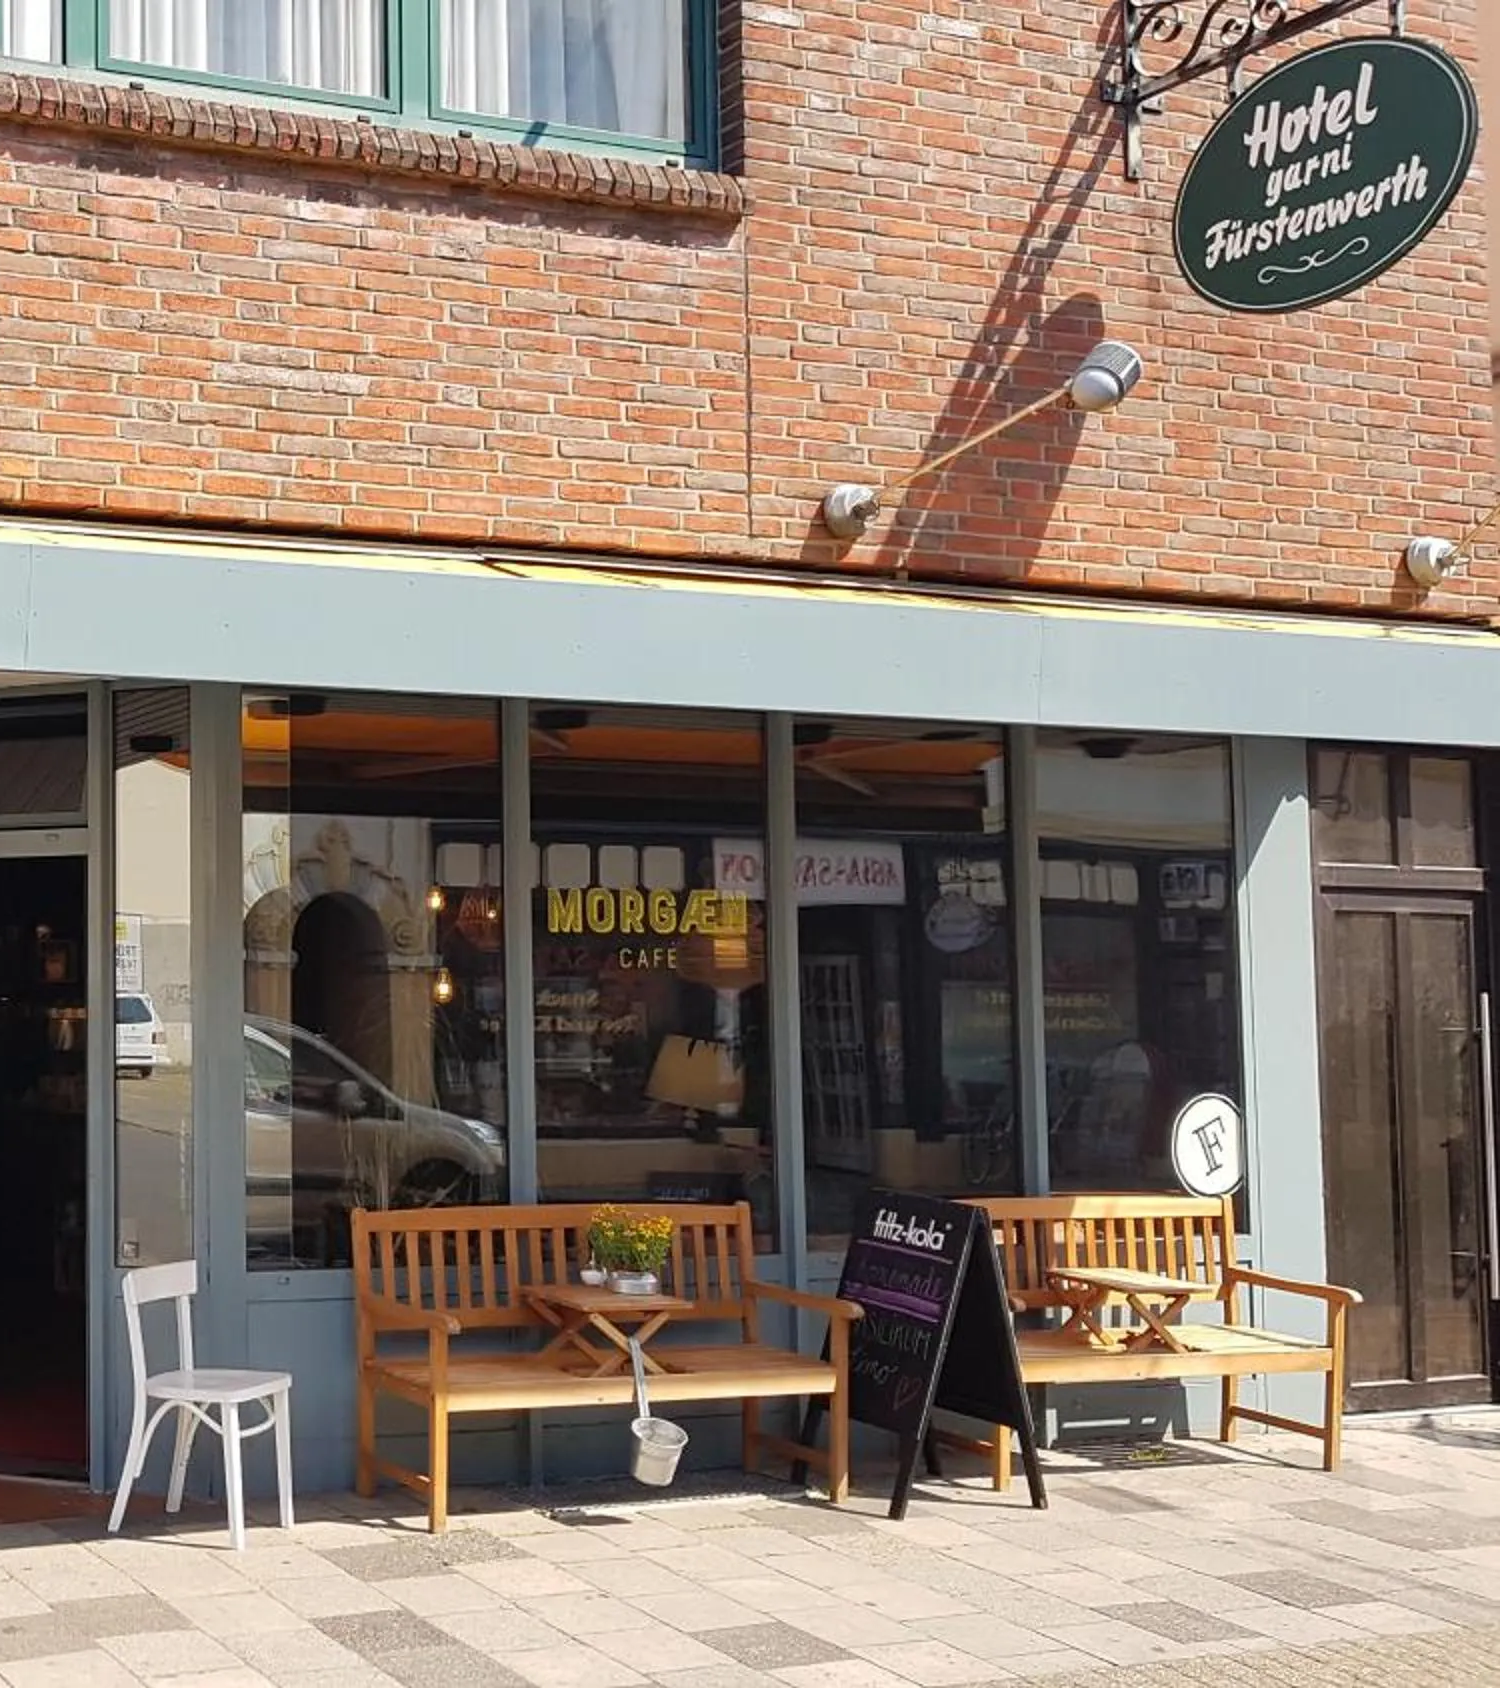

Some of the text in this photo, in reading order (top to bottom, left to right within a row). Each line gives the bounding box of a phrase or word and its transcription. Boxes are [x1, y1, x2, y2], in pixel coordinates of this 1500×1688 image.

[1243, 61, 1378, 168] Hotel
[1264, 131, 1354, 207] garni
[1204, 154, 1429, 270] Fürstenwerth
[1191, 1115, 1226, 1177] F
[873, 1208, 946, 1251] fritz-kola
